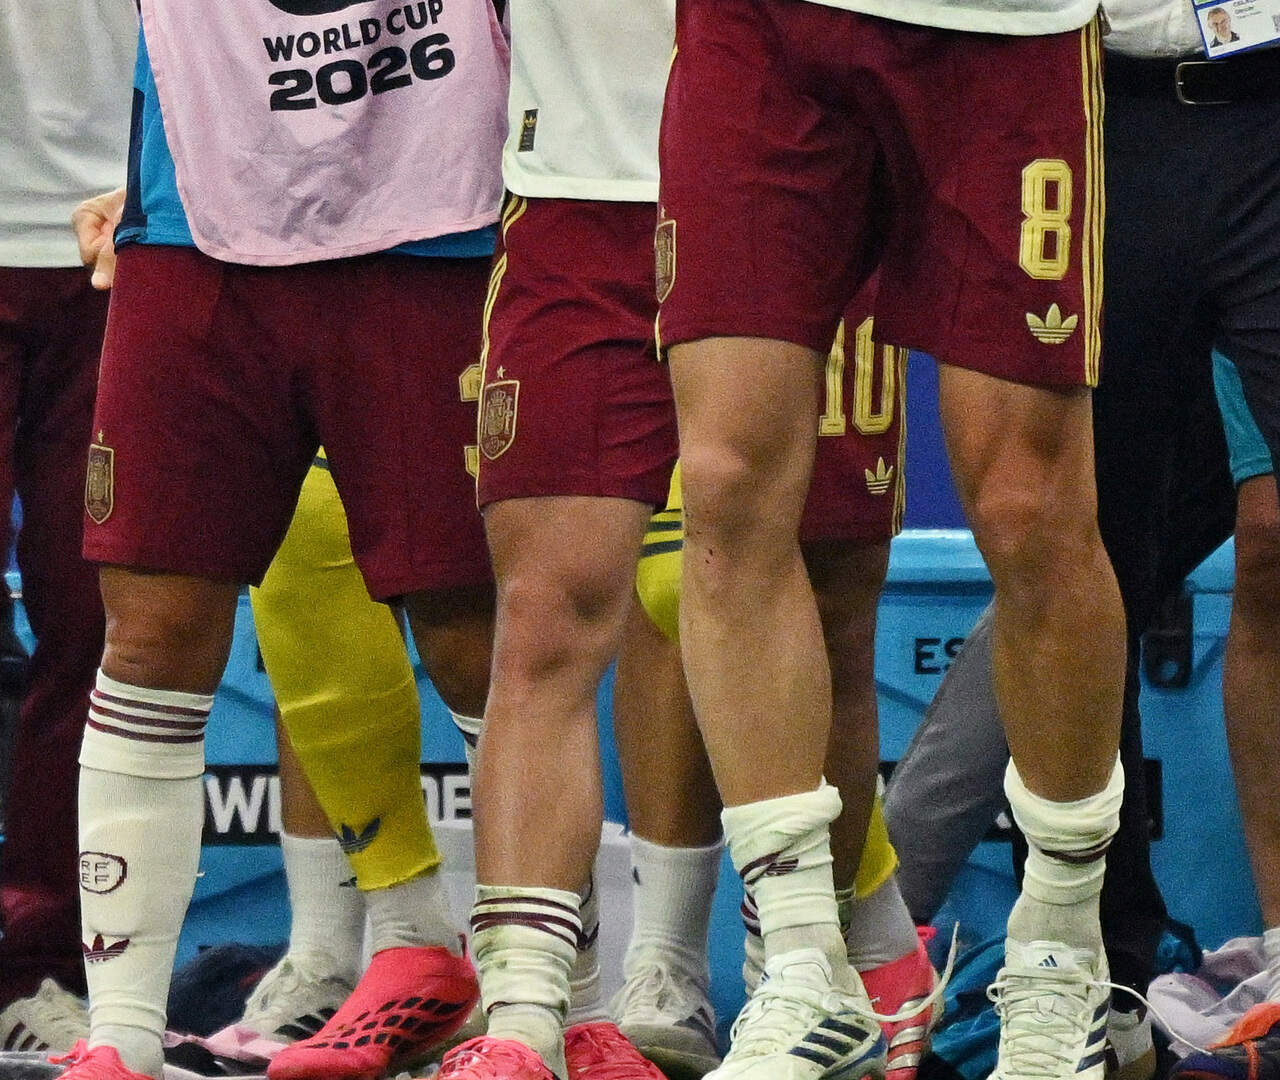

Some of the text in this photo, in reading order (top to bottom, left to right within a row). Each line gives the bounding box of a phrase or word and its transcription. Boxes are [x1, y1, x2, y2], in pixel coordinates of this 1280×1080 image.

[263, 16, 382, 63] WORLD
[269, 32, 455, 111] 2026
[1018, 158, 1073, 280] 8
[818, 316, 896, 437] 10
